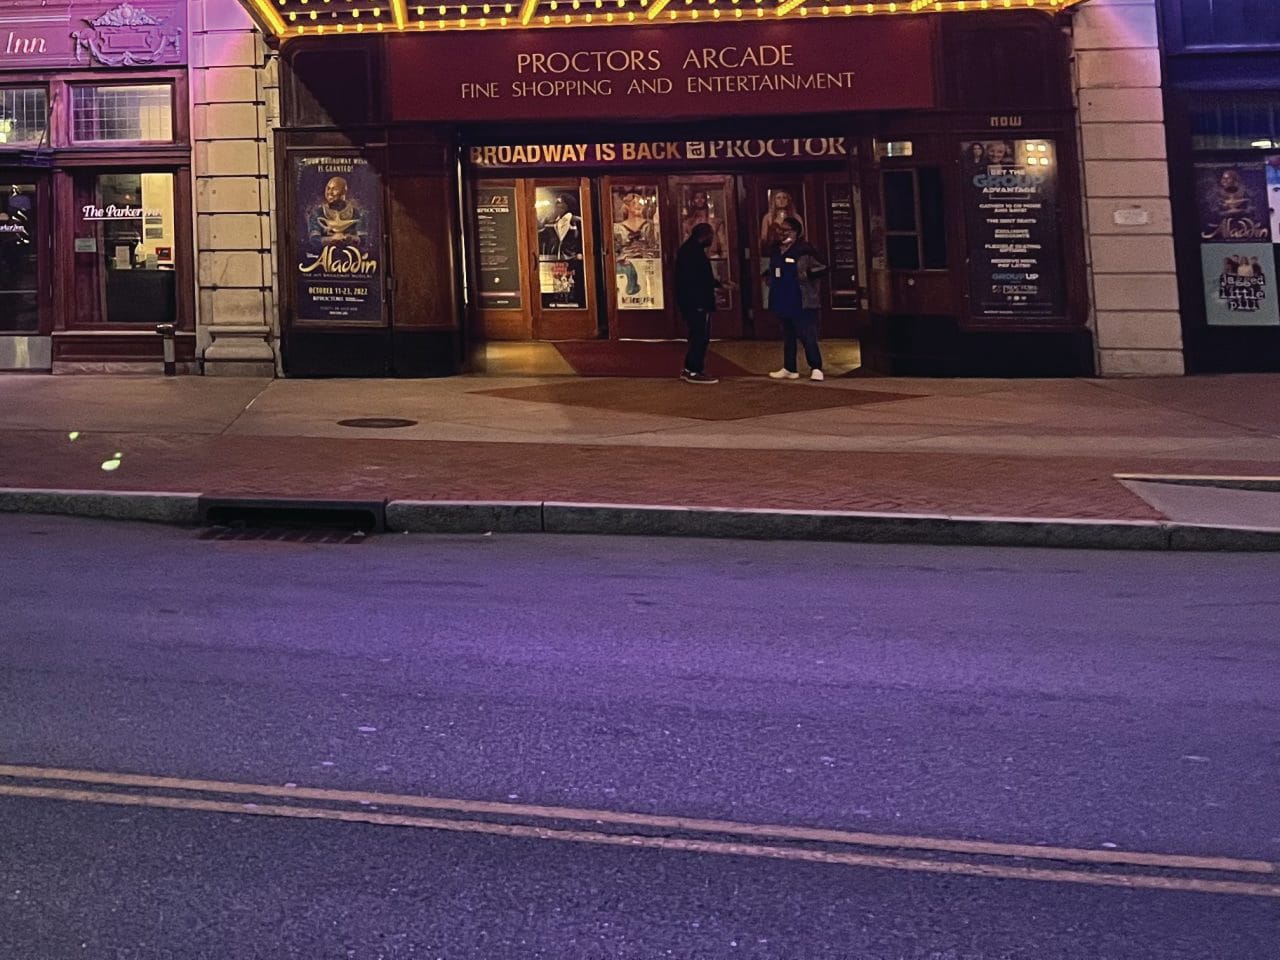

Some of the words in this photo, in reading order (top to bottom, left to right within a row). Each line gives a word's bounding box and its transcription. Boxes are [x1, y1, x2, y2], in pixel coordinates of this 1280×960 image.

[7, 32, 47, 53] Inn
[517, 50, 661, 74] PROCTORS
[682, 45, 794, 69] ARCADE
[461, 82, 500, 98] FINE
[512, 79, 611, 98] SHOPPING
[627, 78, 673, 94] AND
[687, 72, 855, 93] ENTERTAINMENT
[470, 143, 587, 164] BROADWAY
[595, 143, 616, 161] IS
[622, 141, 681, 161] BACK
[709, 137, 857, 158] PROCTOR
[82, 205, 104, 217] The
[106, 204, 143, 217] Parker
[298, 245, 377, 273] Aladdin
[1221, 274, 1264, 286] jagged
[1220, 287, 1264, 298] little
